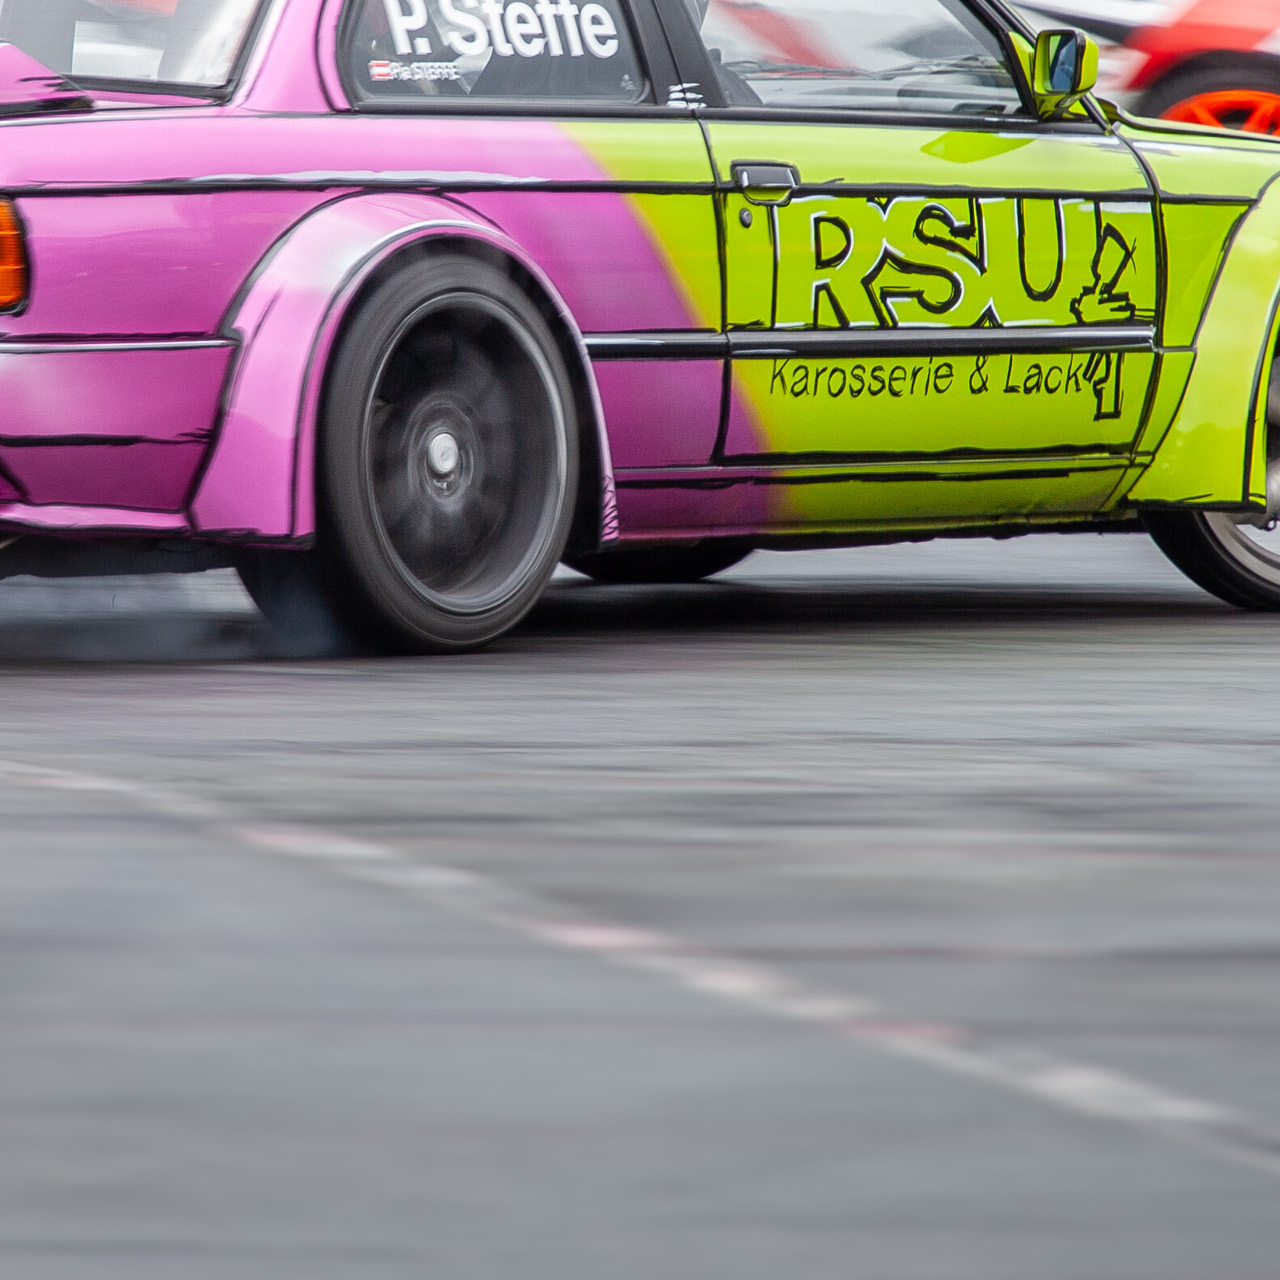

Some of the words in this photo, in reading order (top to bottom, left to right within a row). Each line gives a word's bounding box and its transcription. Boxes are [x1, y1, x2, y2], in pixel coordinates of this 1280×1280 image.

[772, 195, 1100, 328] RSU
[770, 357, 956, 398] Karosserie
[969, 355, 989, 395] &
[1003, 354, 1082, 395] Lack
